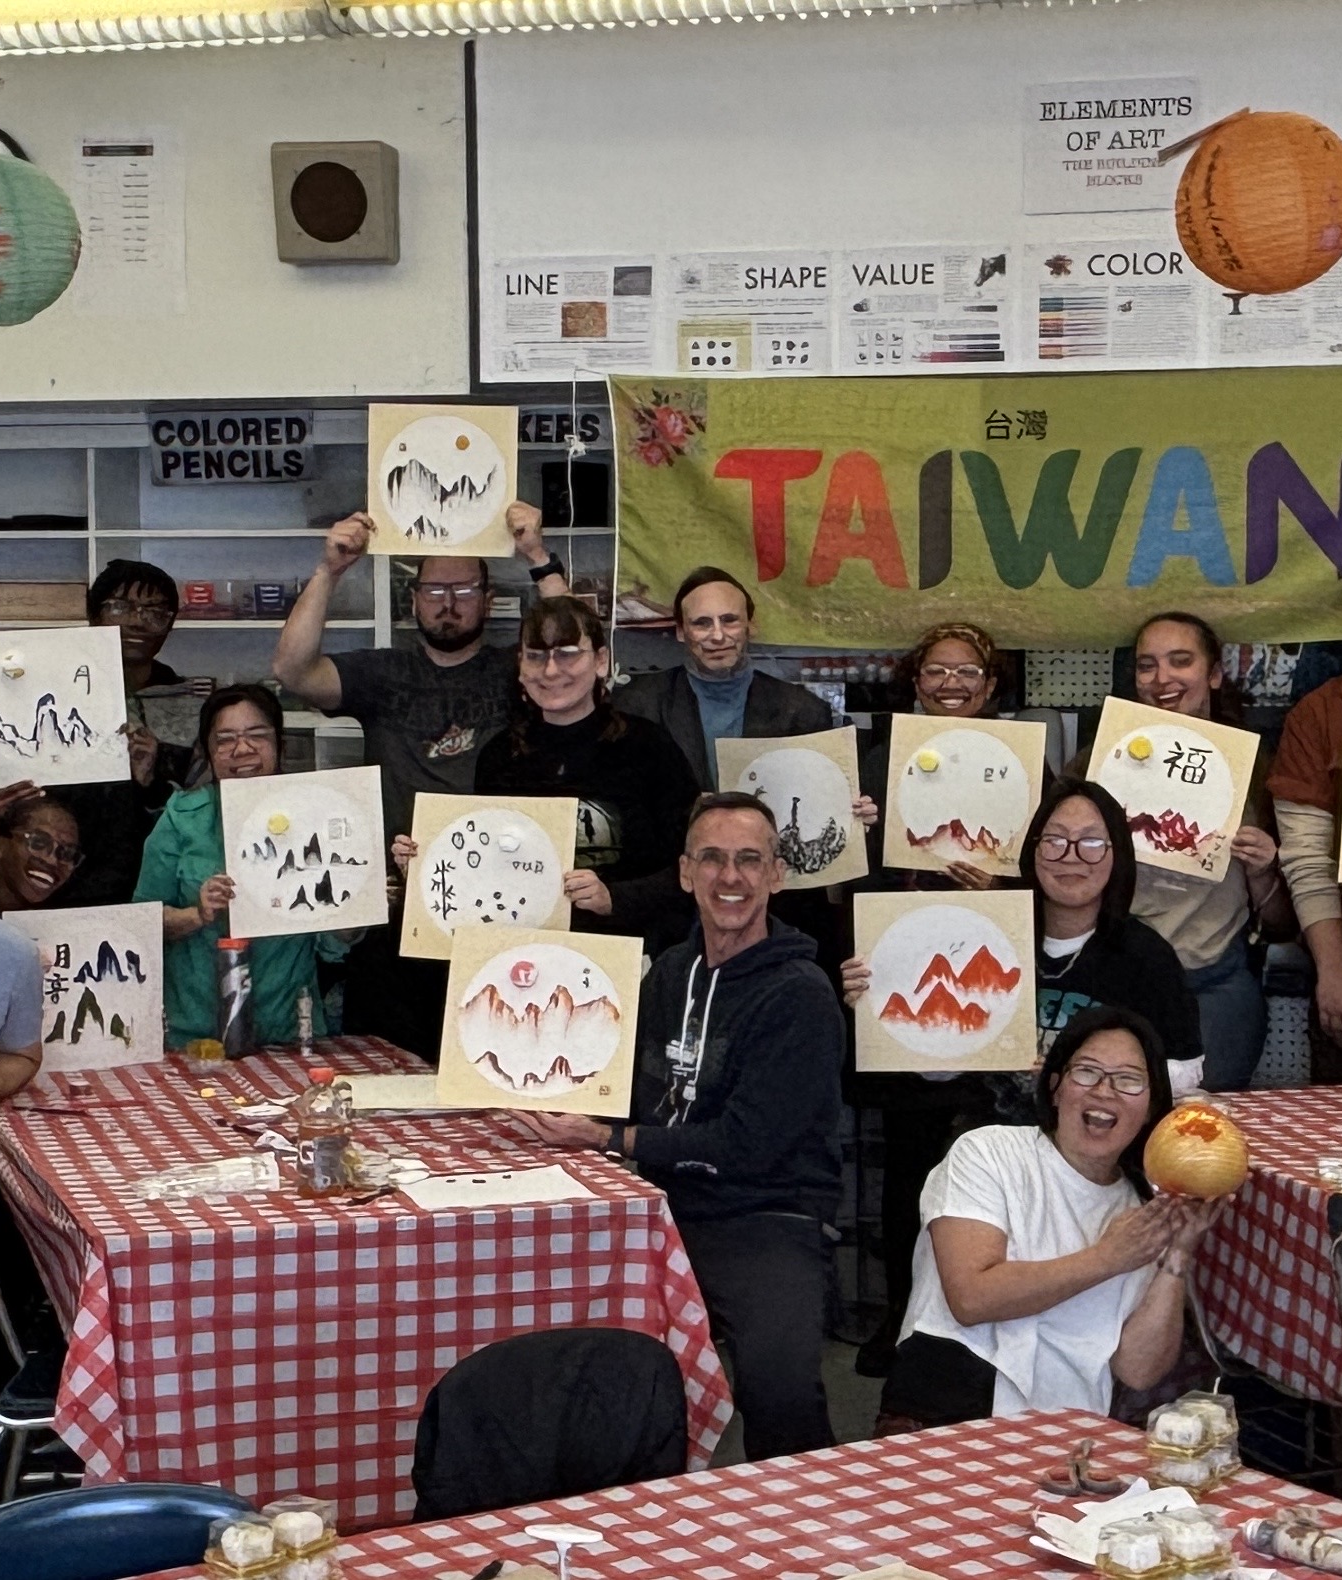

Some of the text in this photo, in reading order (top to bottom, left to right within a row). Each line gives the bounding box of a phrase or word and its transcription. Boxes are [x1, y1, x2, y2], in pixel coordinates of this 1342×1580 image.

[1039, 97, 1193, 122] ELEMENTS
[1066, 128, 1166, 152] OF ART
[852, 263, 935, 287] VALUE
[1087, 252, 1184, 276] COLOR
[505, 273, 559, 297] LINE
[744, 266, 827, 290] SHAPE
[152, 417, 307, 447] COLORED
[161, 449, 305, 479] PENCILS
